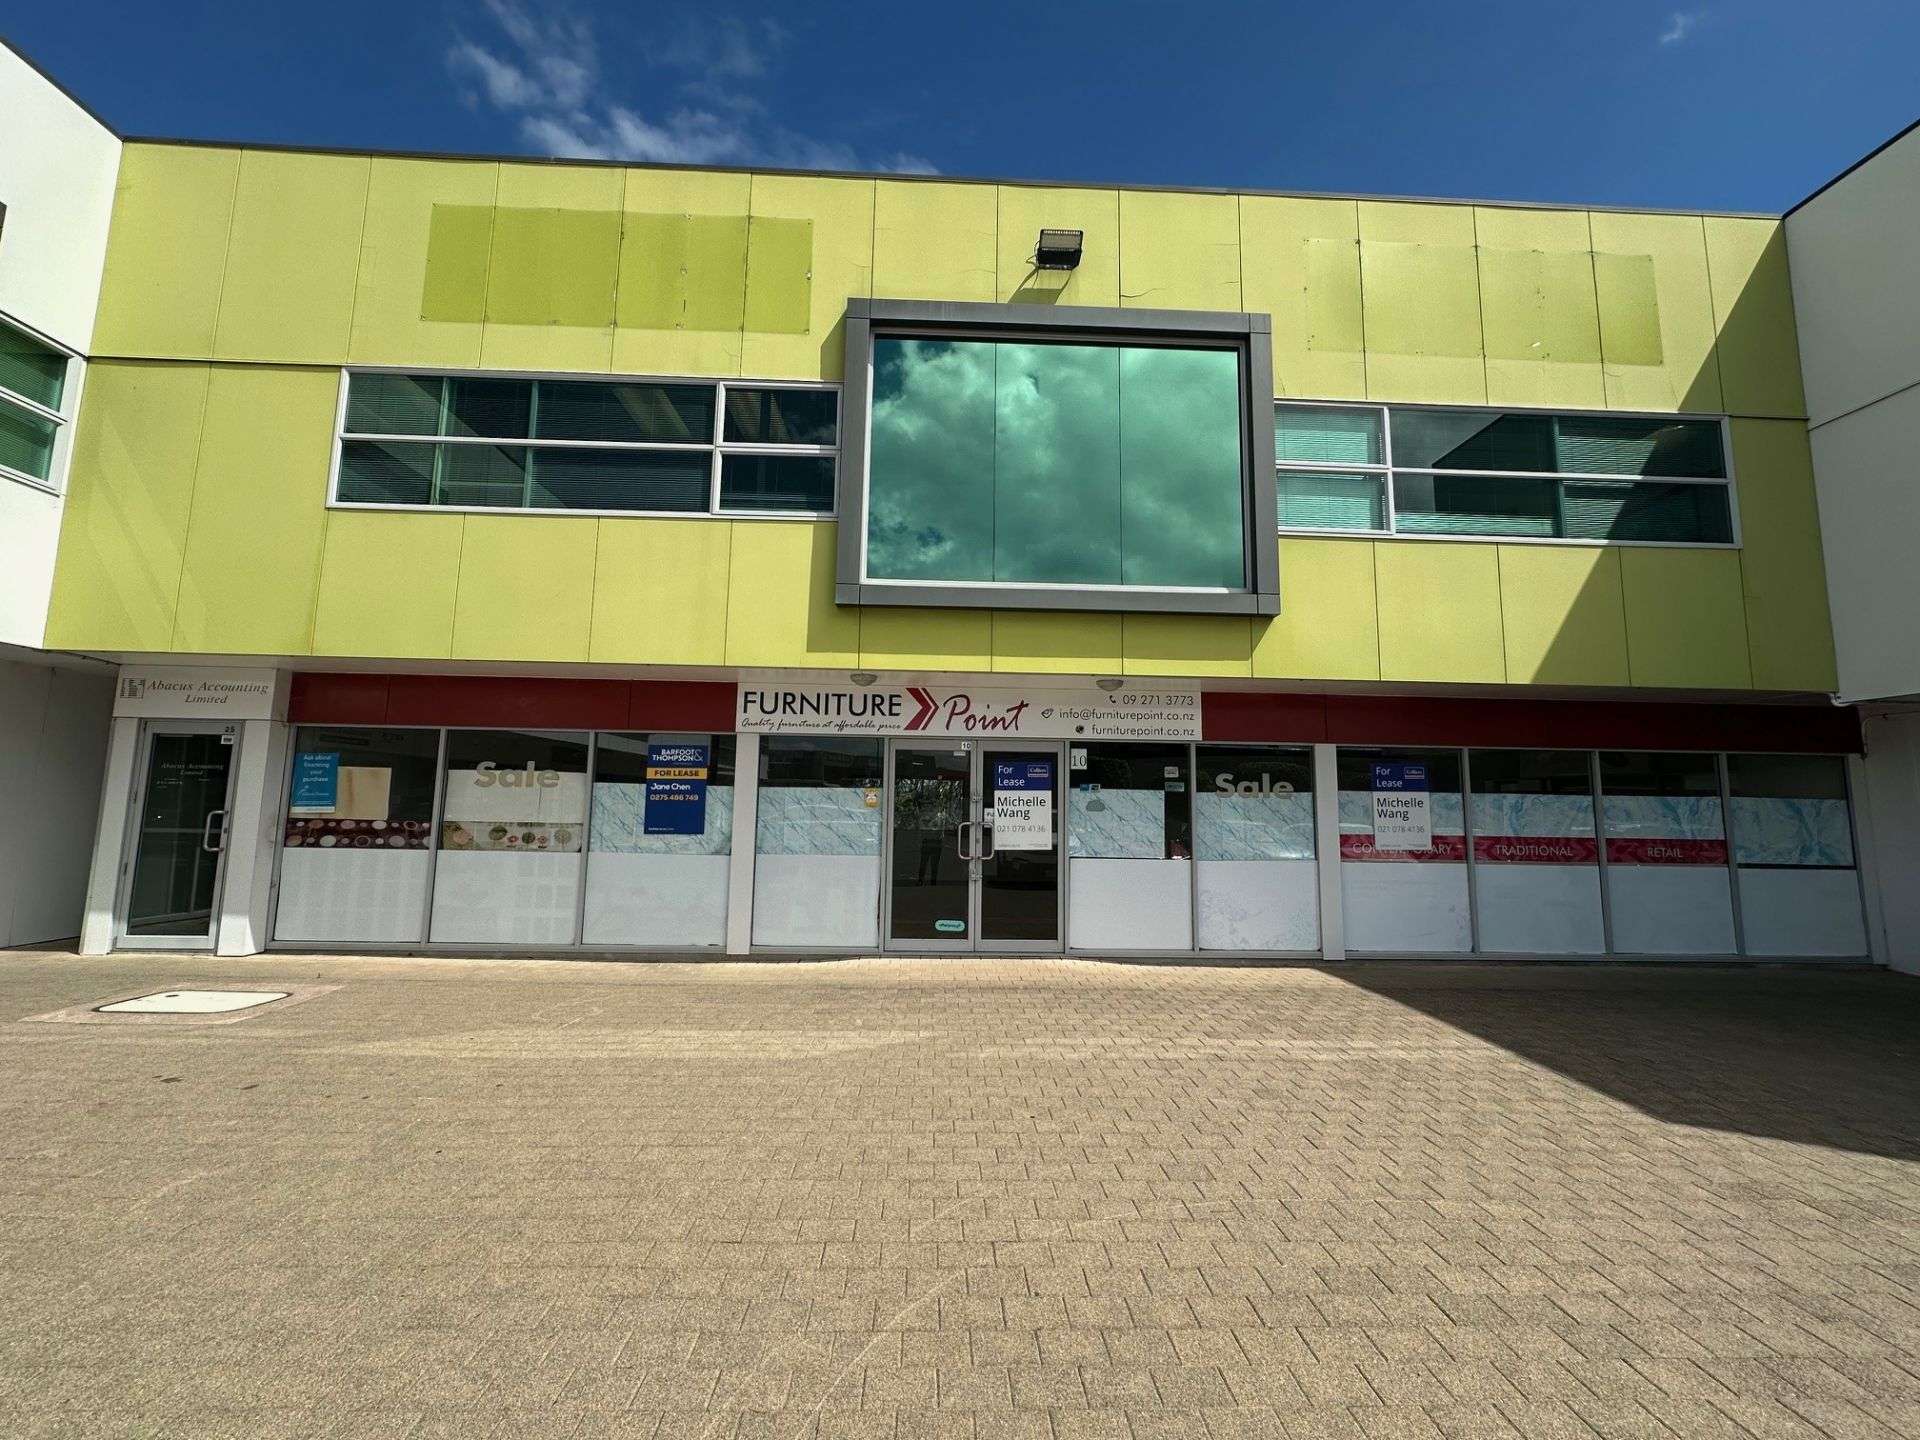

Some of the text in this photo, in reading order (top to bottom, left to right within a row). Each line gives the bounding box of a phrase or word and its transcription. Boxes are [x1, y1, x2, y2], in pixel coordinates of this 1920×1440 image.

[147, 680, 269, 695] Abacus Accounting
[184, 694, 229, 704] Limited
[743, 691, 902, 717] FURNITURE
[1122, 694, 1194, 706] 09 271 3773
[943, 694, 1029, 731] Point
[1059, 708, 1195, 722] info@furniturepoint.co.nz
[742, 717, 775, 730] Quality
[777, 719, 820, 731] furniture
[834, 719, 876, 732] affordable
[1091, 724, 1195, 737] furniturepoint.co.nz
[652, 754, 694, 762] THOMPSON
[1072, 755, 1087, 767] 10
[473, 760, 560, 788] Sale
[654, 769, 700, 777] FOR LEASE
[998, 765, 1013, 774] For
[1376, 766, 1391, 775] For
[998, 778, 1025, 786] Lease
[1215, 772, 1295, 799] Sale
[1376, 779, 1403, 788] Lease
[997, 796, 1047, 807] Michelle
[1376, 797, 1424, 808] Michelle
[997, 808, 1031, 820] Wang
[1376, 808, 1410, 821] Wang
[1494, 845, 1574, 857] TRADITIONAL
[1647, 847, 1683, 858] RETAIL
